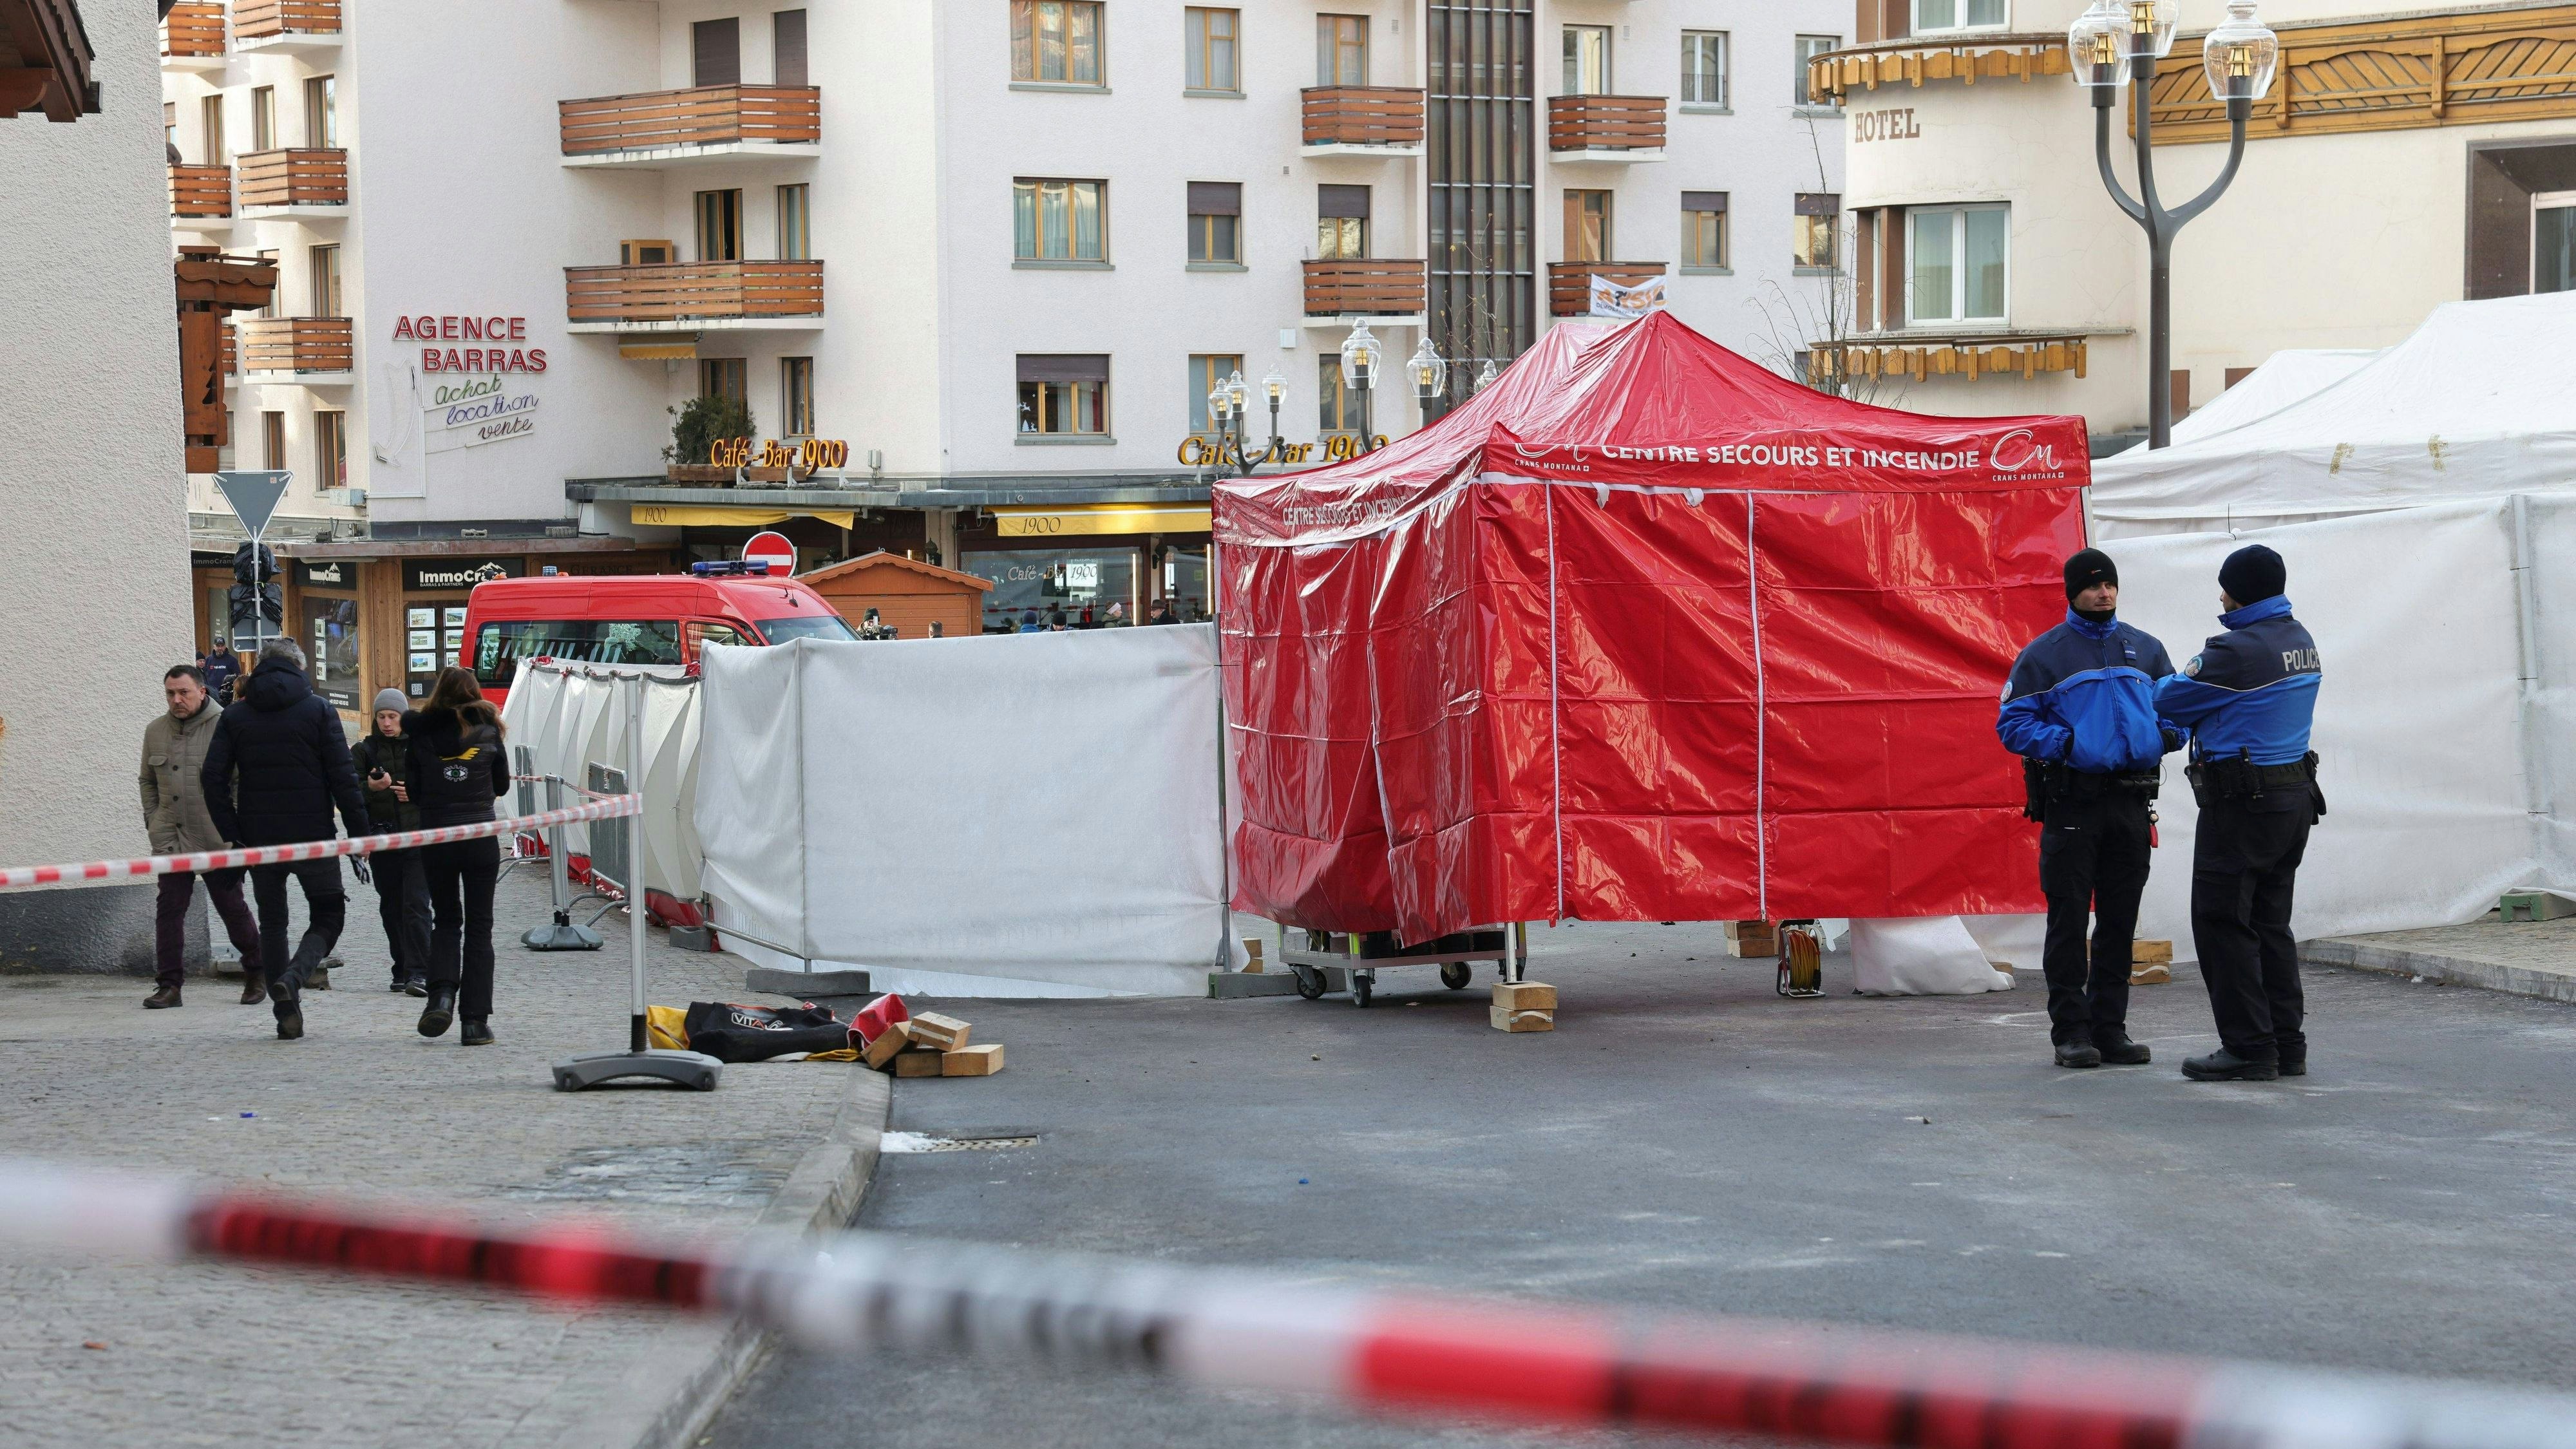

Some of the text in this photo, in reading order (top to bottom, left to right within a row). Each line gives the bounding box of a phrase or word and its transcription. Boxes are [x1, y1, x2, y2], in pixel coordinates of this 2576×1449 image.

[1855, 108, 1920, 143] HOTEL
[392, 315, 526, 340] AGENCE
[422, 348, 547, 372] BARRAS
[435, 373, 502, 405] achat
[446, 393, 540, 426] location
[477, 417, 533, 440] vente
[711, 436, 751, 468] Café
[762, 439, 795, 468] Bar
[799, 439, 848, 476] 1900
[1515, 459, 1581, 471] CRANS MONTANA
[1601, 445, 1700, 462] CENTRE
[1707, 444, 1819, 466] SECOURS
[1826, 447, 1855, 467] ET
[1862, 449, 1980, 470] INCENDIE
[2020, 472, 2056, 480] MONTANA
[644, 507, 667, 522] 1900
[1353, 502, 1362, 521] ET
[1021, 517, 1061, 535] 1900
[419, 569, 507, 583] ImmoCr
[1007, 565, 1036, 580] Café
[1045, 565, 1066, 580] Bar
[1071, 565, 1098, 580] 1900
[2282, 648, 2320, 672] POLICE
